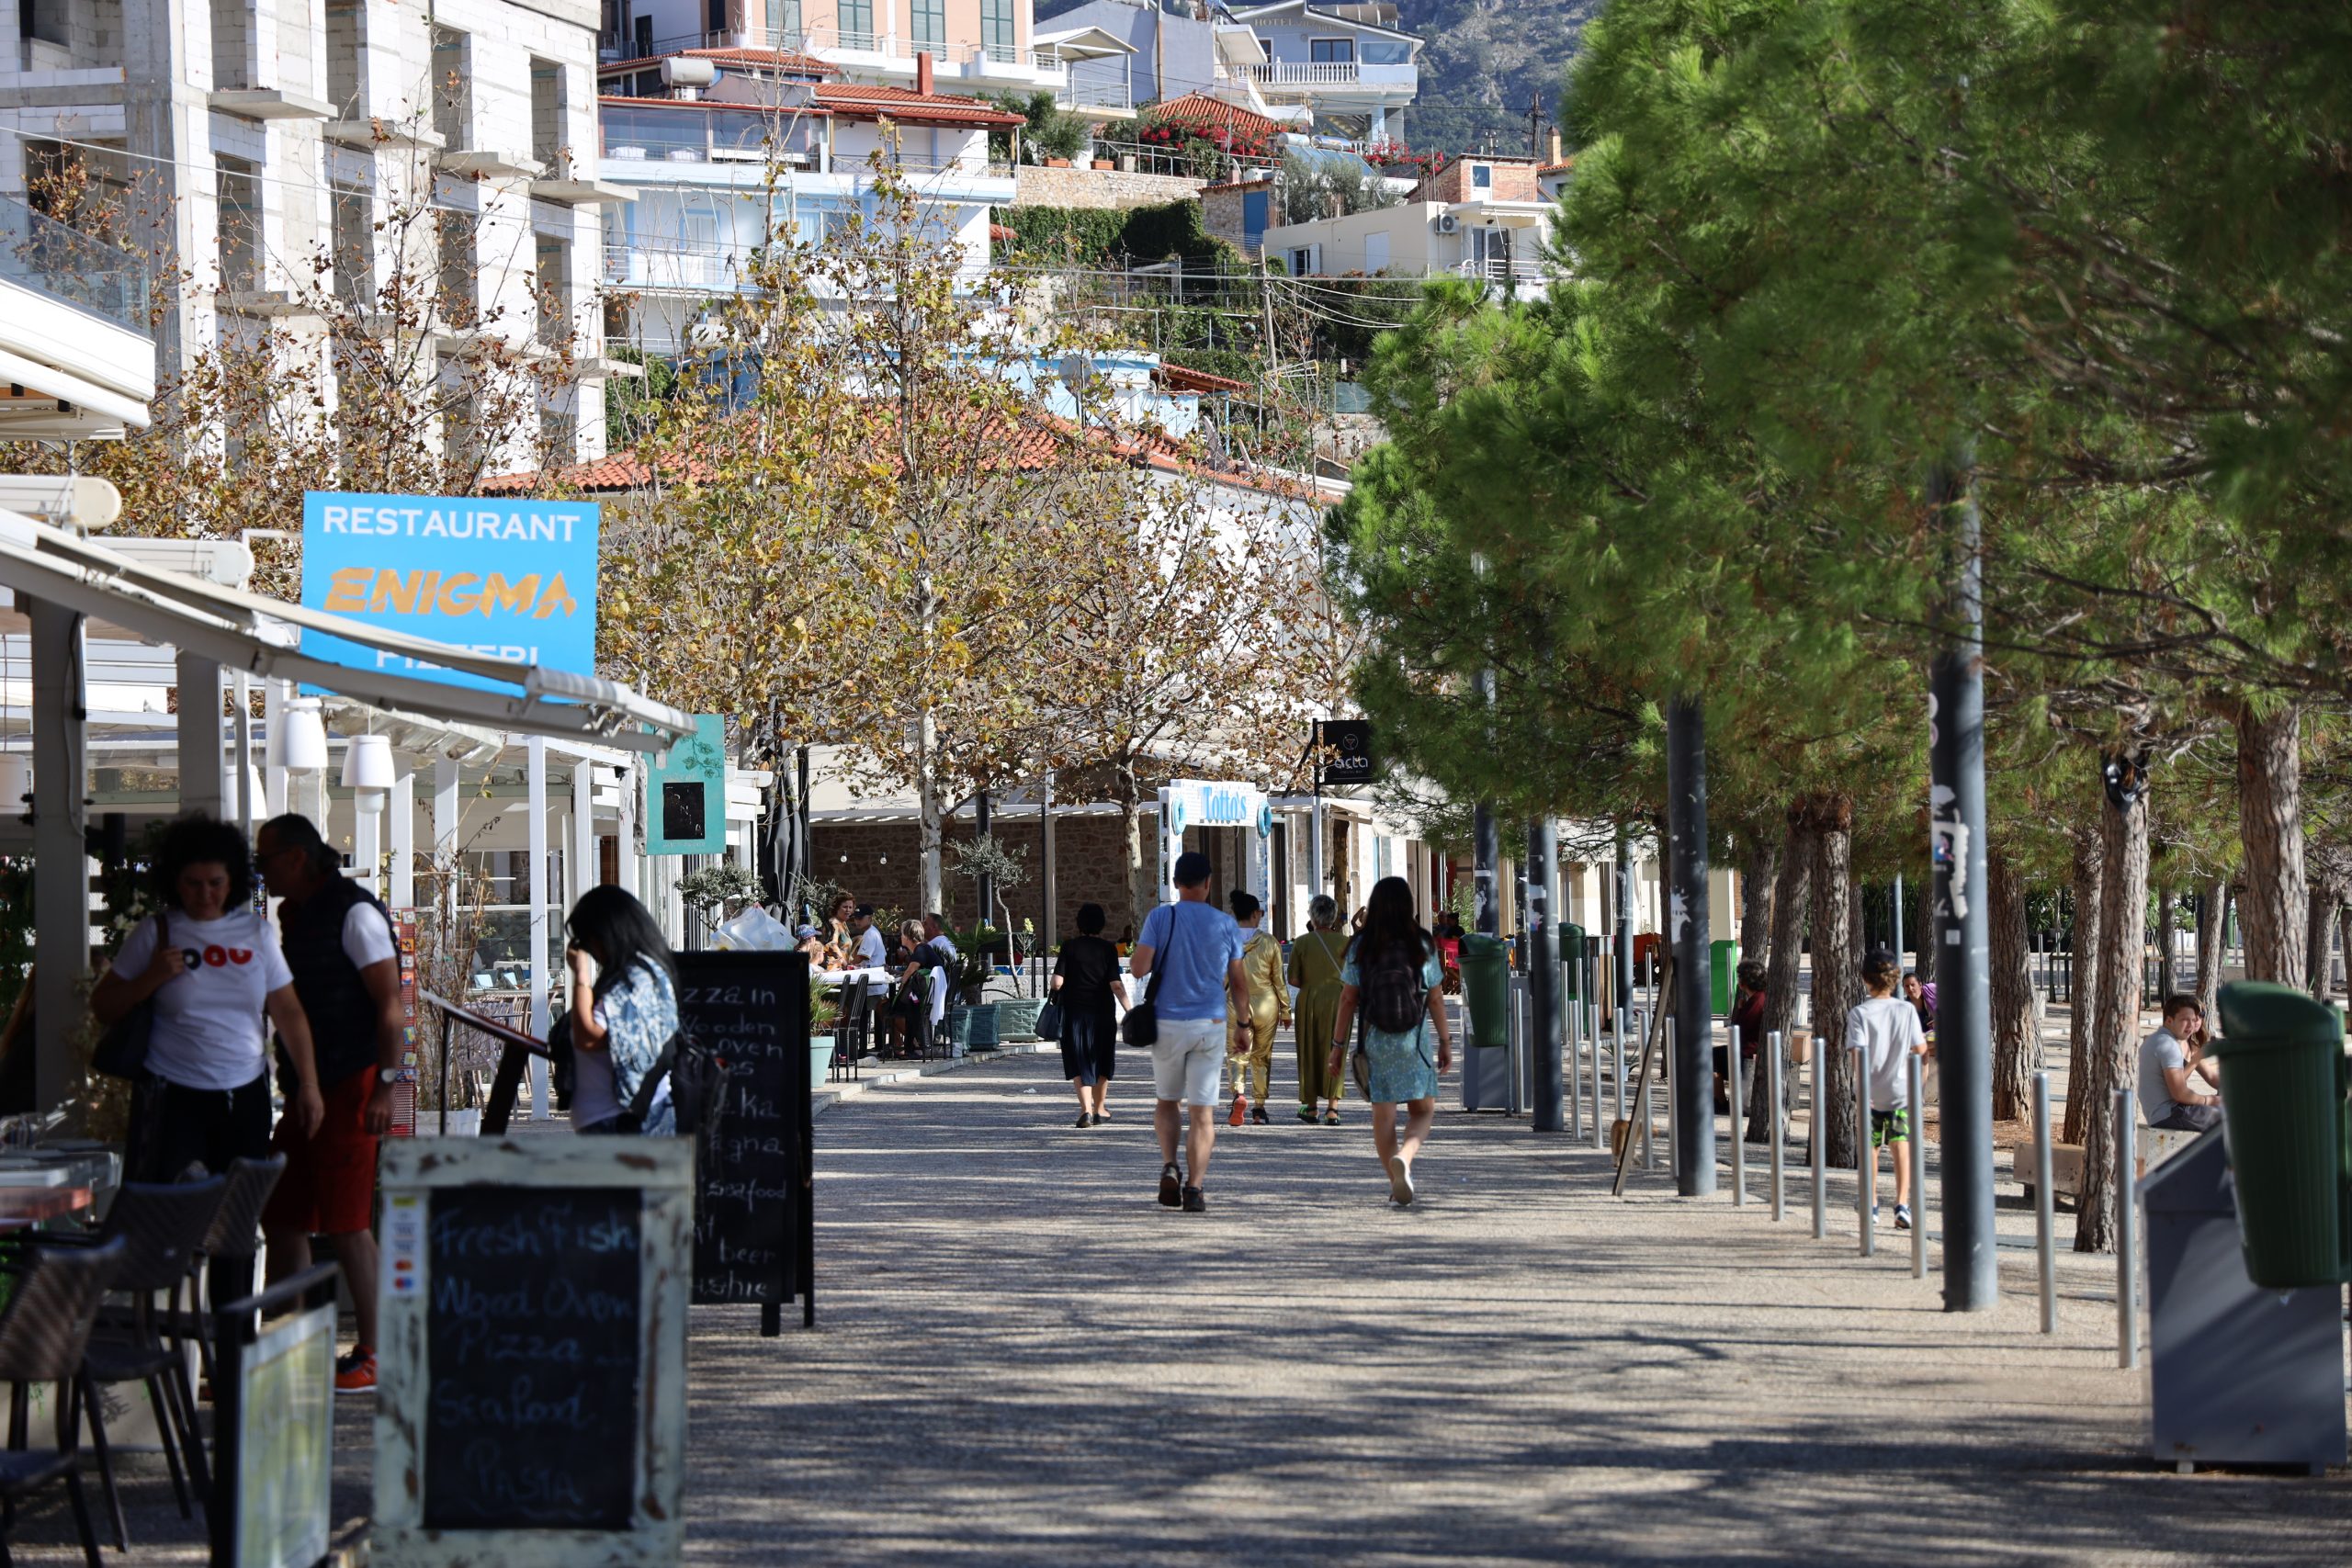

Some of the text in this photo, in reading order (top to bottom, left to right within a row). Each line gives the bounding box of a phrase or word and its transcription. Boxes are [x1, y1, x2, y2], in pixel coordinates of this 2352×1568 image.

[323, 506, 581, 543] RESTAURANT
[323, 567, 578, 619] ENIGMA
[1203, 786, 1248, 820] Totto's
[752, 987, 776, 1005] in
[718, 1037, 784, 1060] oven
[431, 1205, 542, 1258] Fresh
[538, 1199, 637, 1253] Fish
[719, 1235, 775, 1264] beer
[434, 1275, 537, 1318] Wood
[441, 1317, 584, 1366] Pizza
